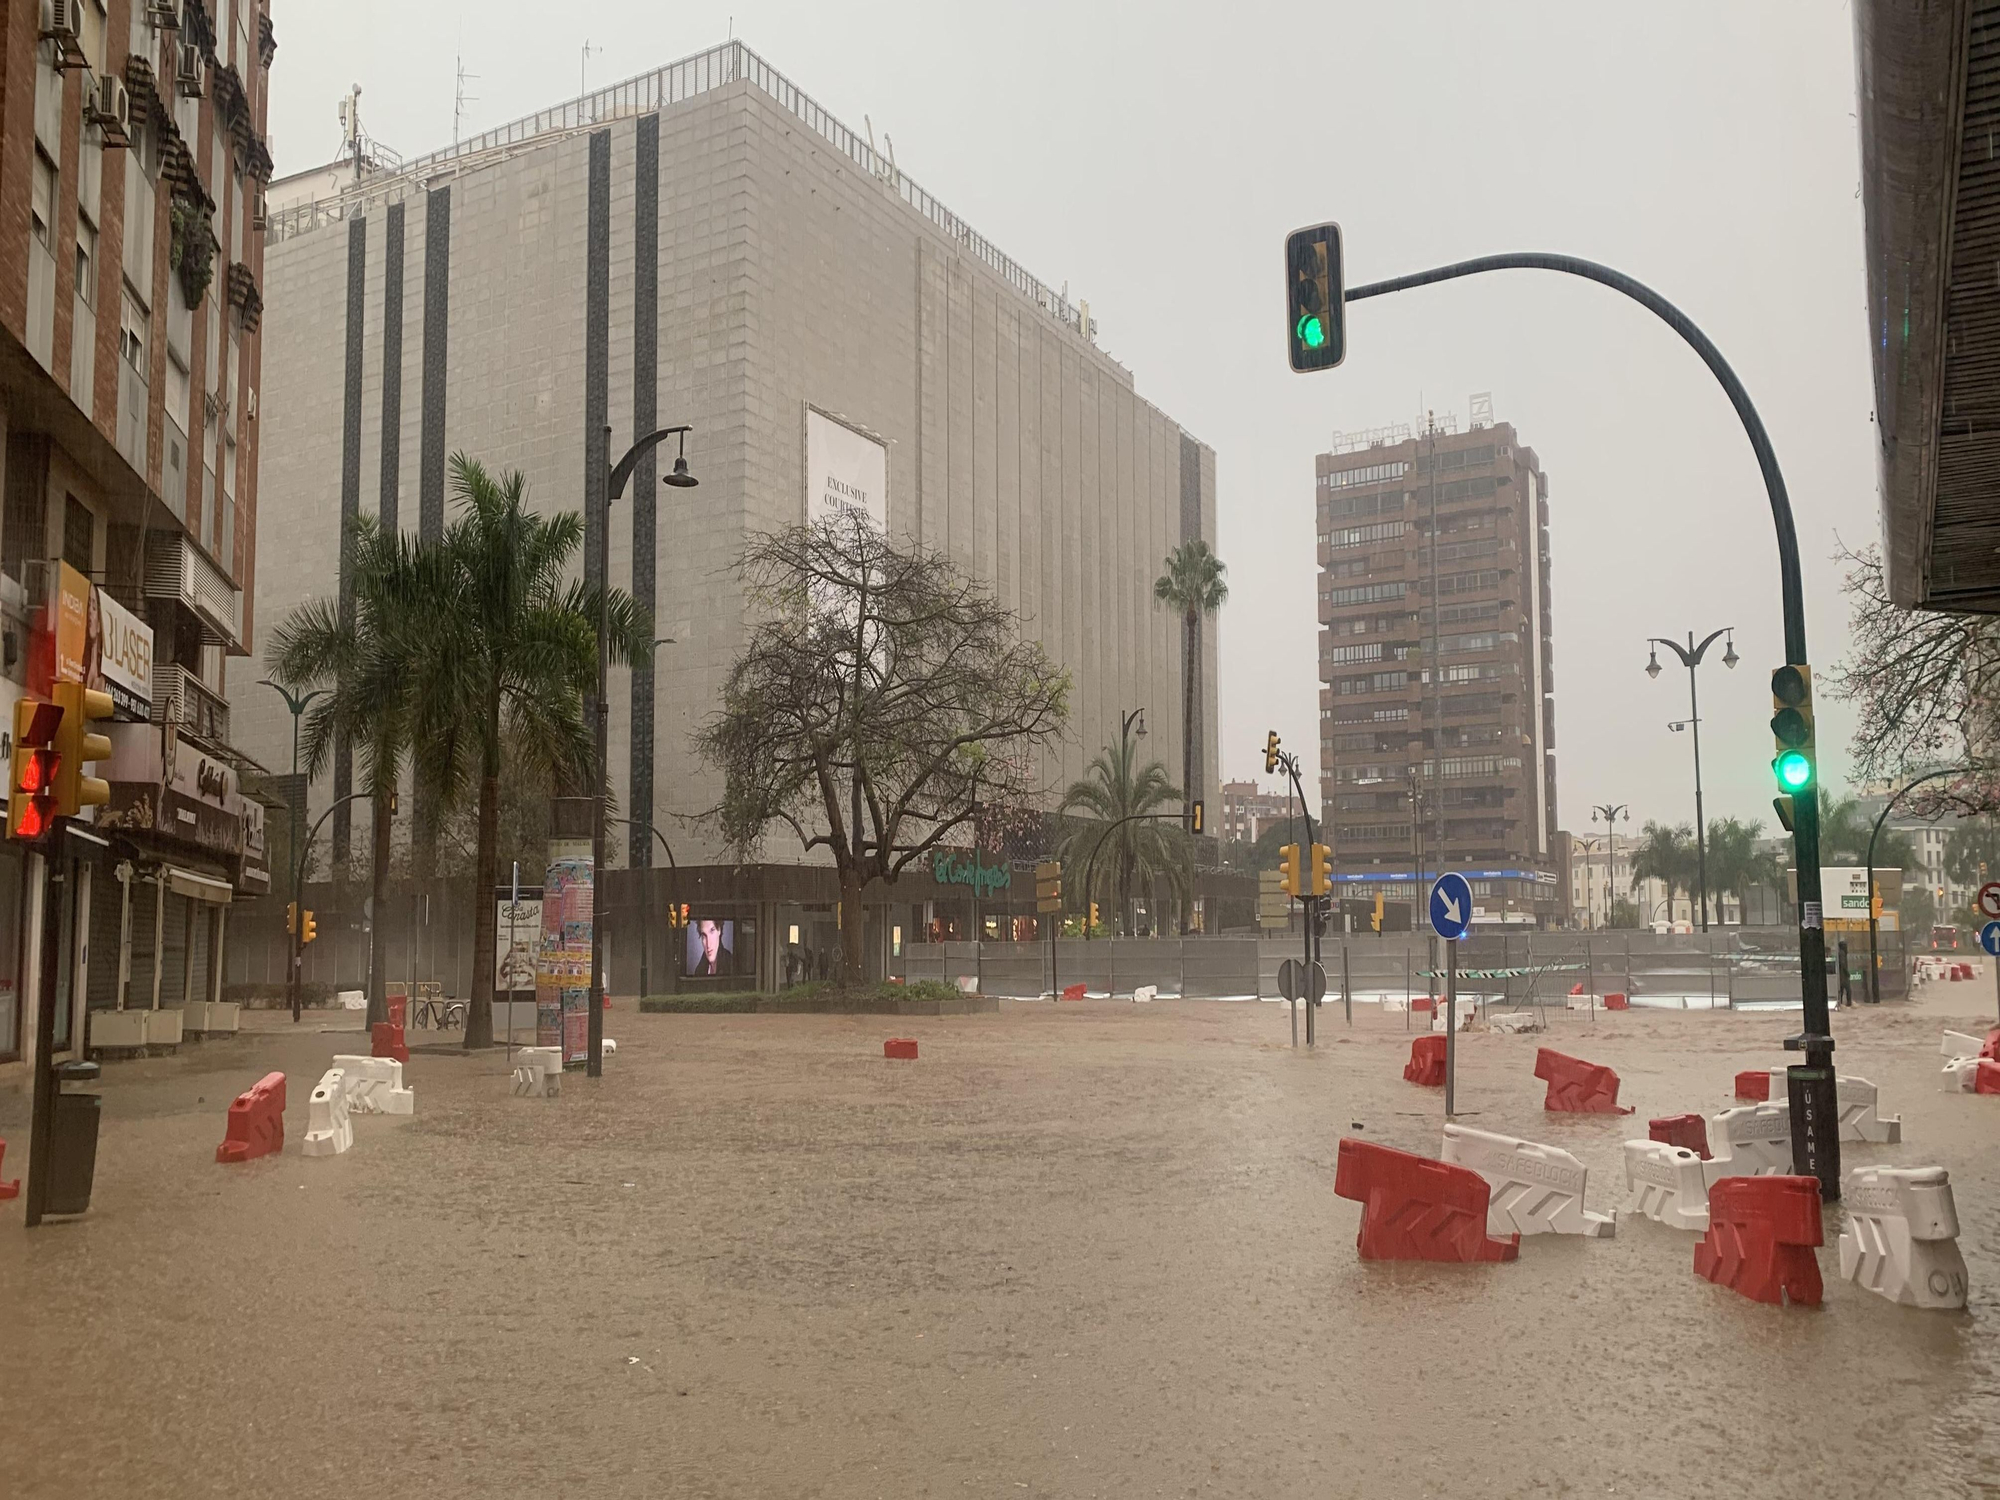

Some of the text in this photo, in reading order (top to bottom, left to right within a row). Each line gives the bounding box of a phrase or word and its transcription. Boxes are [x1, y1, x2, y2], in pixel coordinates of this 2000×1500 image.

[827, 476, 867, 504] EXCLUSIVE
[824, 493, 870, 520] COURTESIES
[934, 849, 1011, 898] El Corte Inglés
[501, 903, 540, 921] Canasta
[1849, 971, 1862, 981] ando
[1804, 1089, 1816, 1170] ÚSAME
